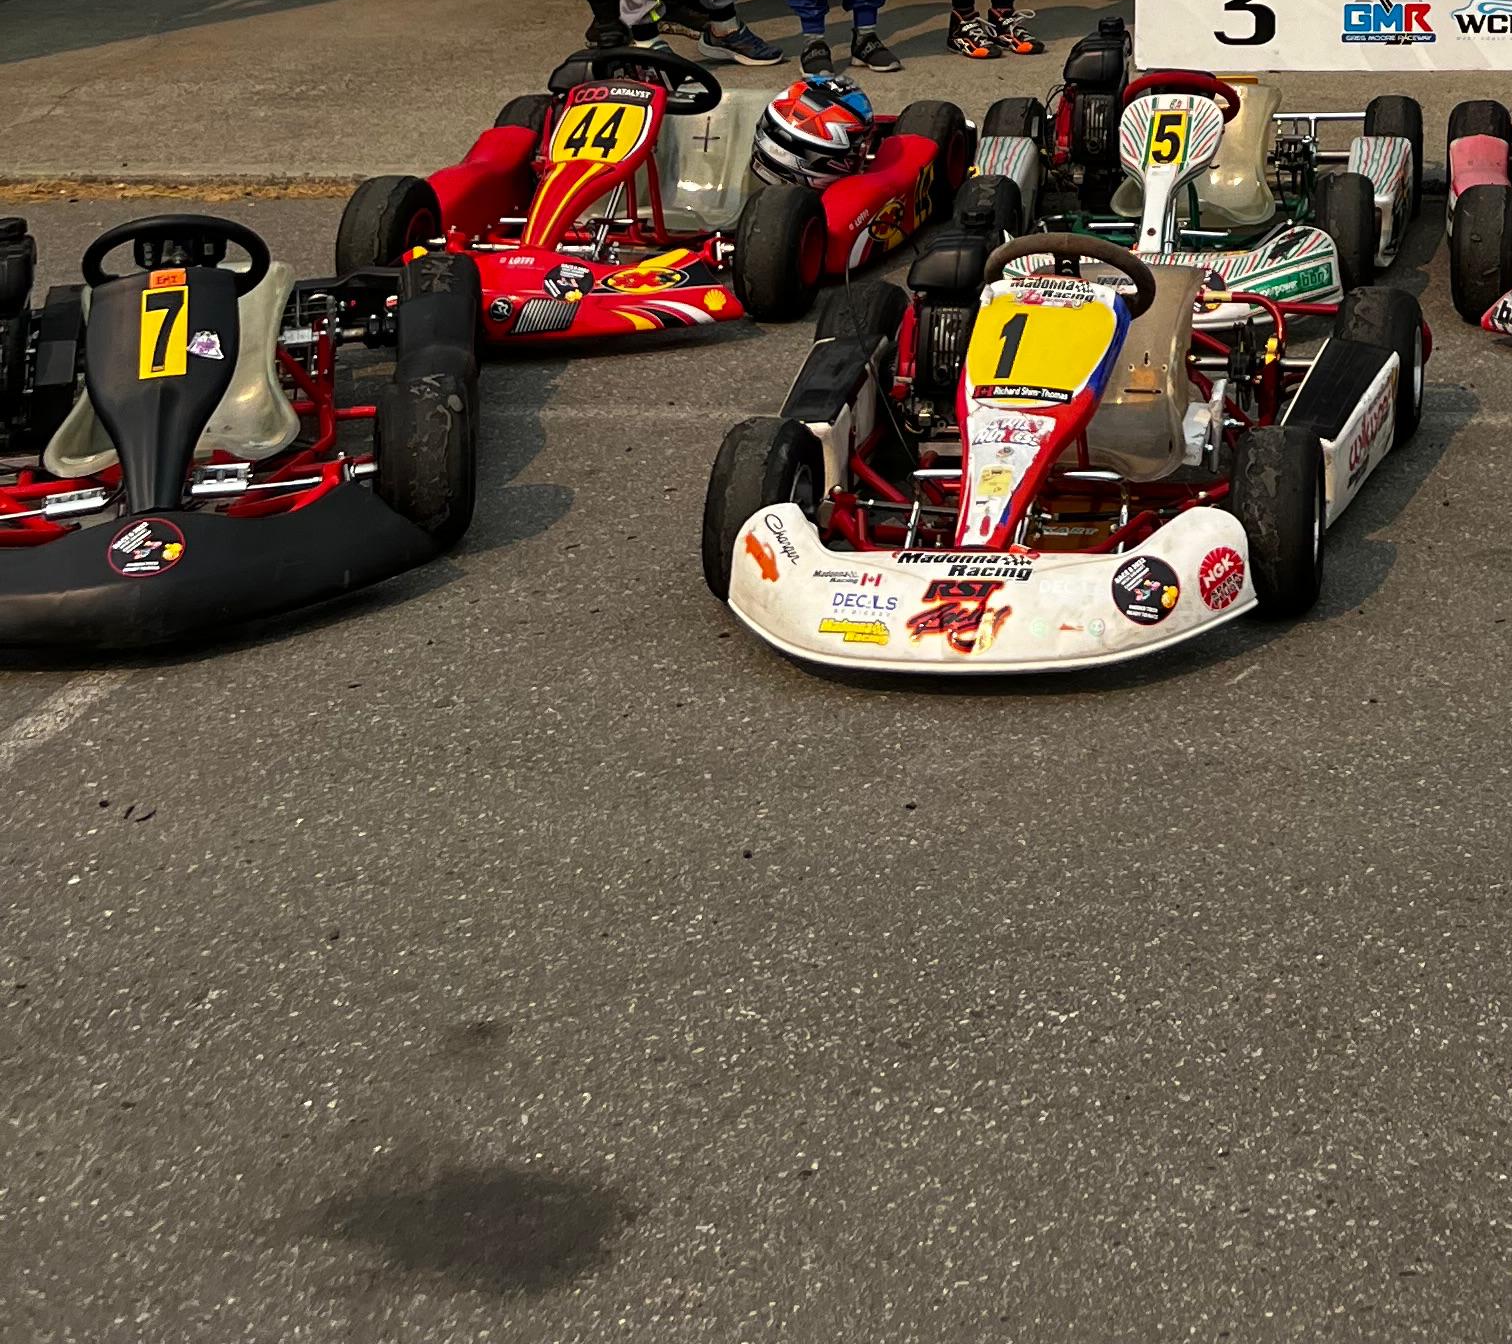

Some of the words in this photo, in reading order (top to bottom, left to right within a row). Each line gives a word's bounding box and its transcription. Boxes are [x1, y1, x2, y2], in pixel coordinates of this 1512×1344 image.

[1343, 3, 1434, 33] GMR
[609, 87, 652, 99] CATALYST
[563, 106, 627, 159] 44
[1151, 114, 1183, 164] 5
[1009, 276, 1076, 291] Madonna
[145, 290, 185, 372] 7
[993, 313, 1029, 379] 1
[897, 552, 1002, 564] Madonna
[948, 564, 1034, 582] Racing
[1203, 552, 1235, 589] NGK
